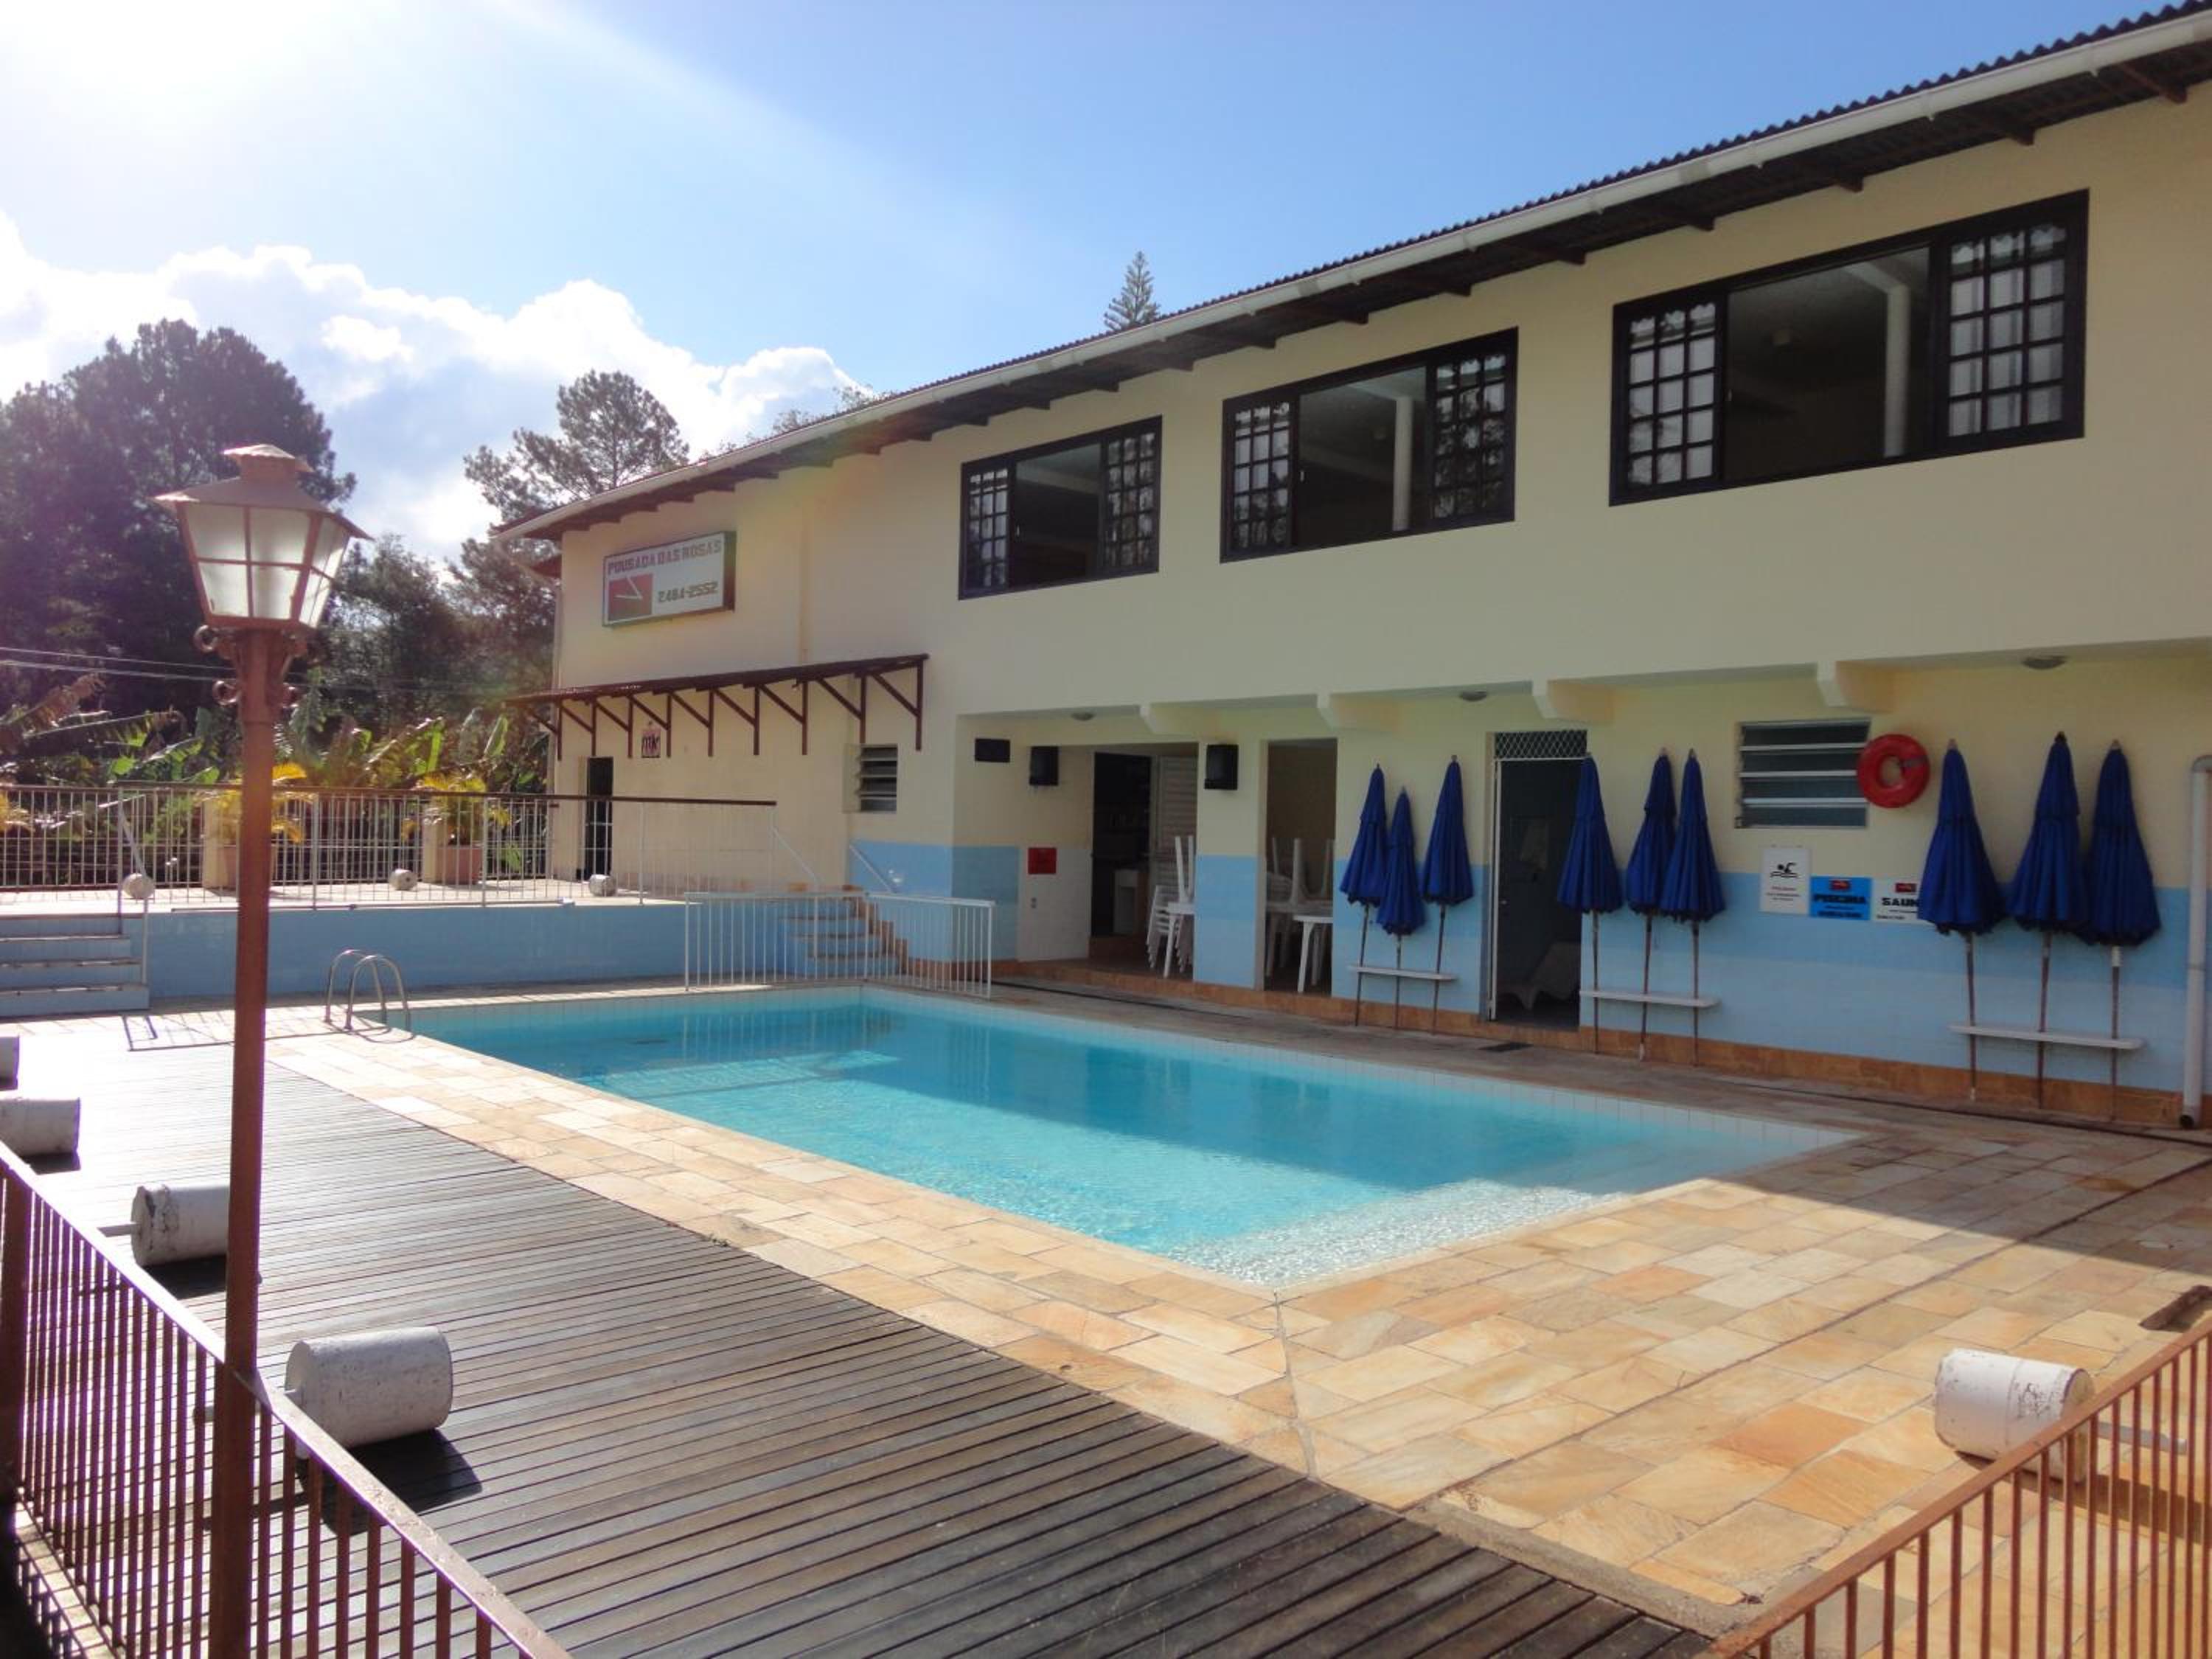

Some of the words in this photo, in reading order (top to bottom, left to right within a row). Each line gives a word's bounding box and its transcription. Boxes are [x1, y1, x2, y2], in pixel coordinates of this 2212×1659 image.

[608, 557, 655, 574] POUSADA
[658, 550, 681, 565] DAS
[684, 540, 722, 559] ROSAS
[1881, 897, 1919, 907] SAUN
